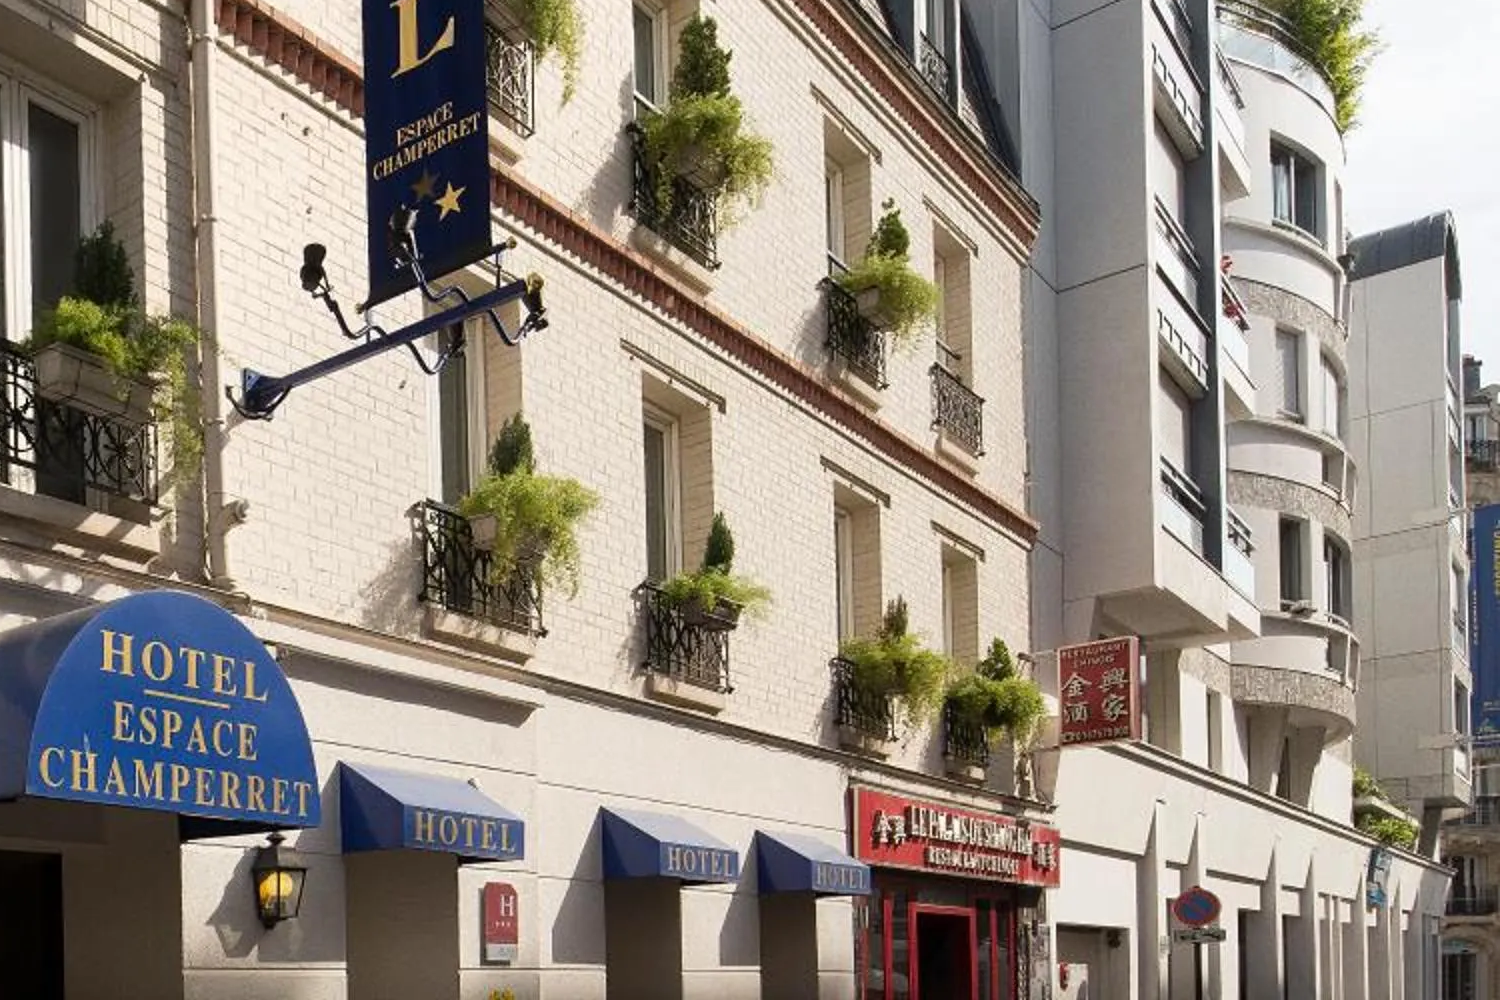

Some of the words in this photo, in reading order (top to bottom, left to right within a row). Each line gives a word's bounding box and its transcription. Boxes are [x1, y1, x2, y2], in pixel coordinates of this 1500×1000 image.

[372, 111, 482, 181] CHAMPERRET
[395, 101, 454, 148] ESPACE
[100, 629, 270, 703] HOTEL
[112, 701, 258, 761] ESPACE
[38, 746, 315, 818] CHAMPERRET
[414, 810, 516, 852] HOTEL
[667, 846, 734, 878] HOTEL
[816, 864, 868, 890] HOTEL
[500, 894, 515, 917] H
